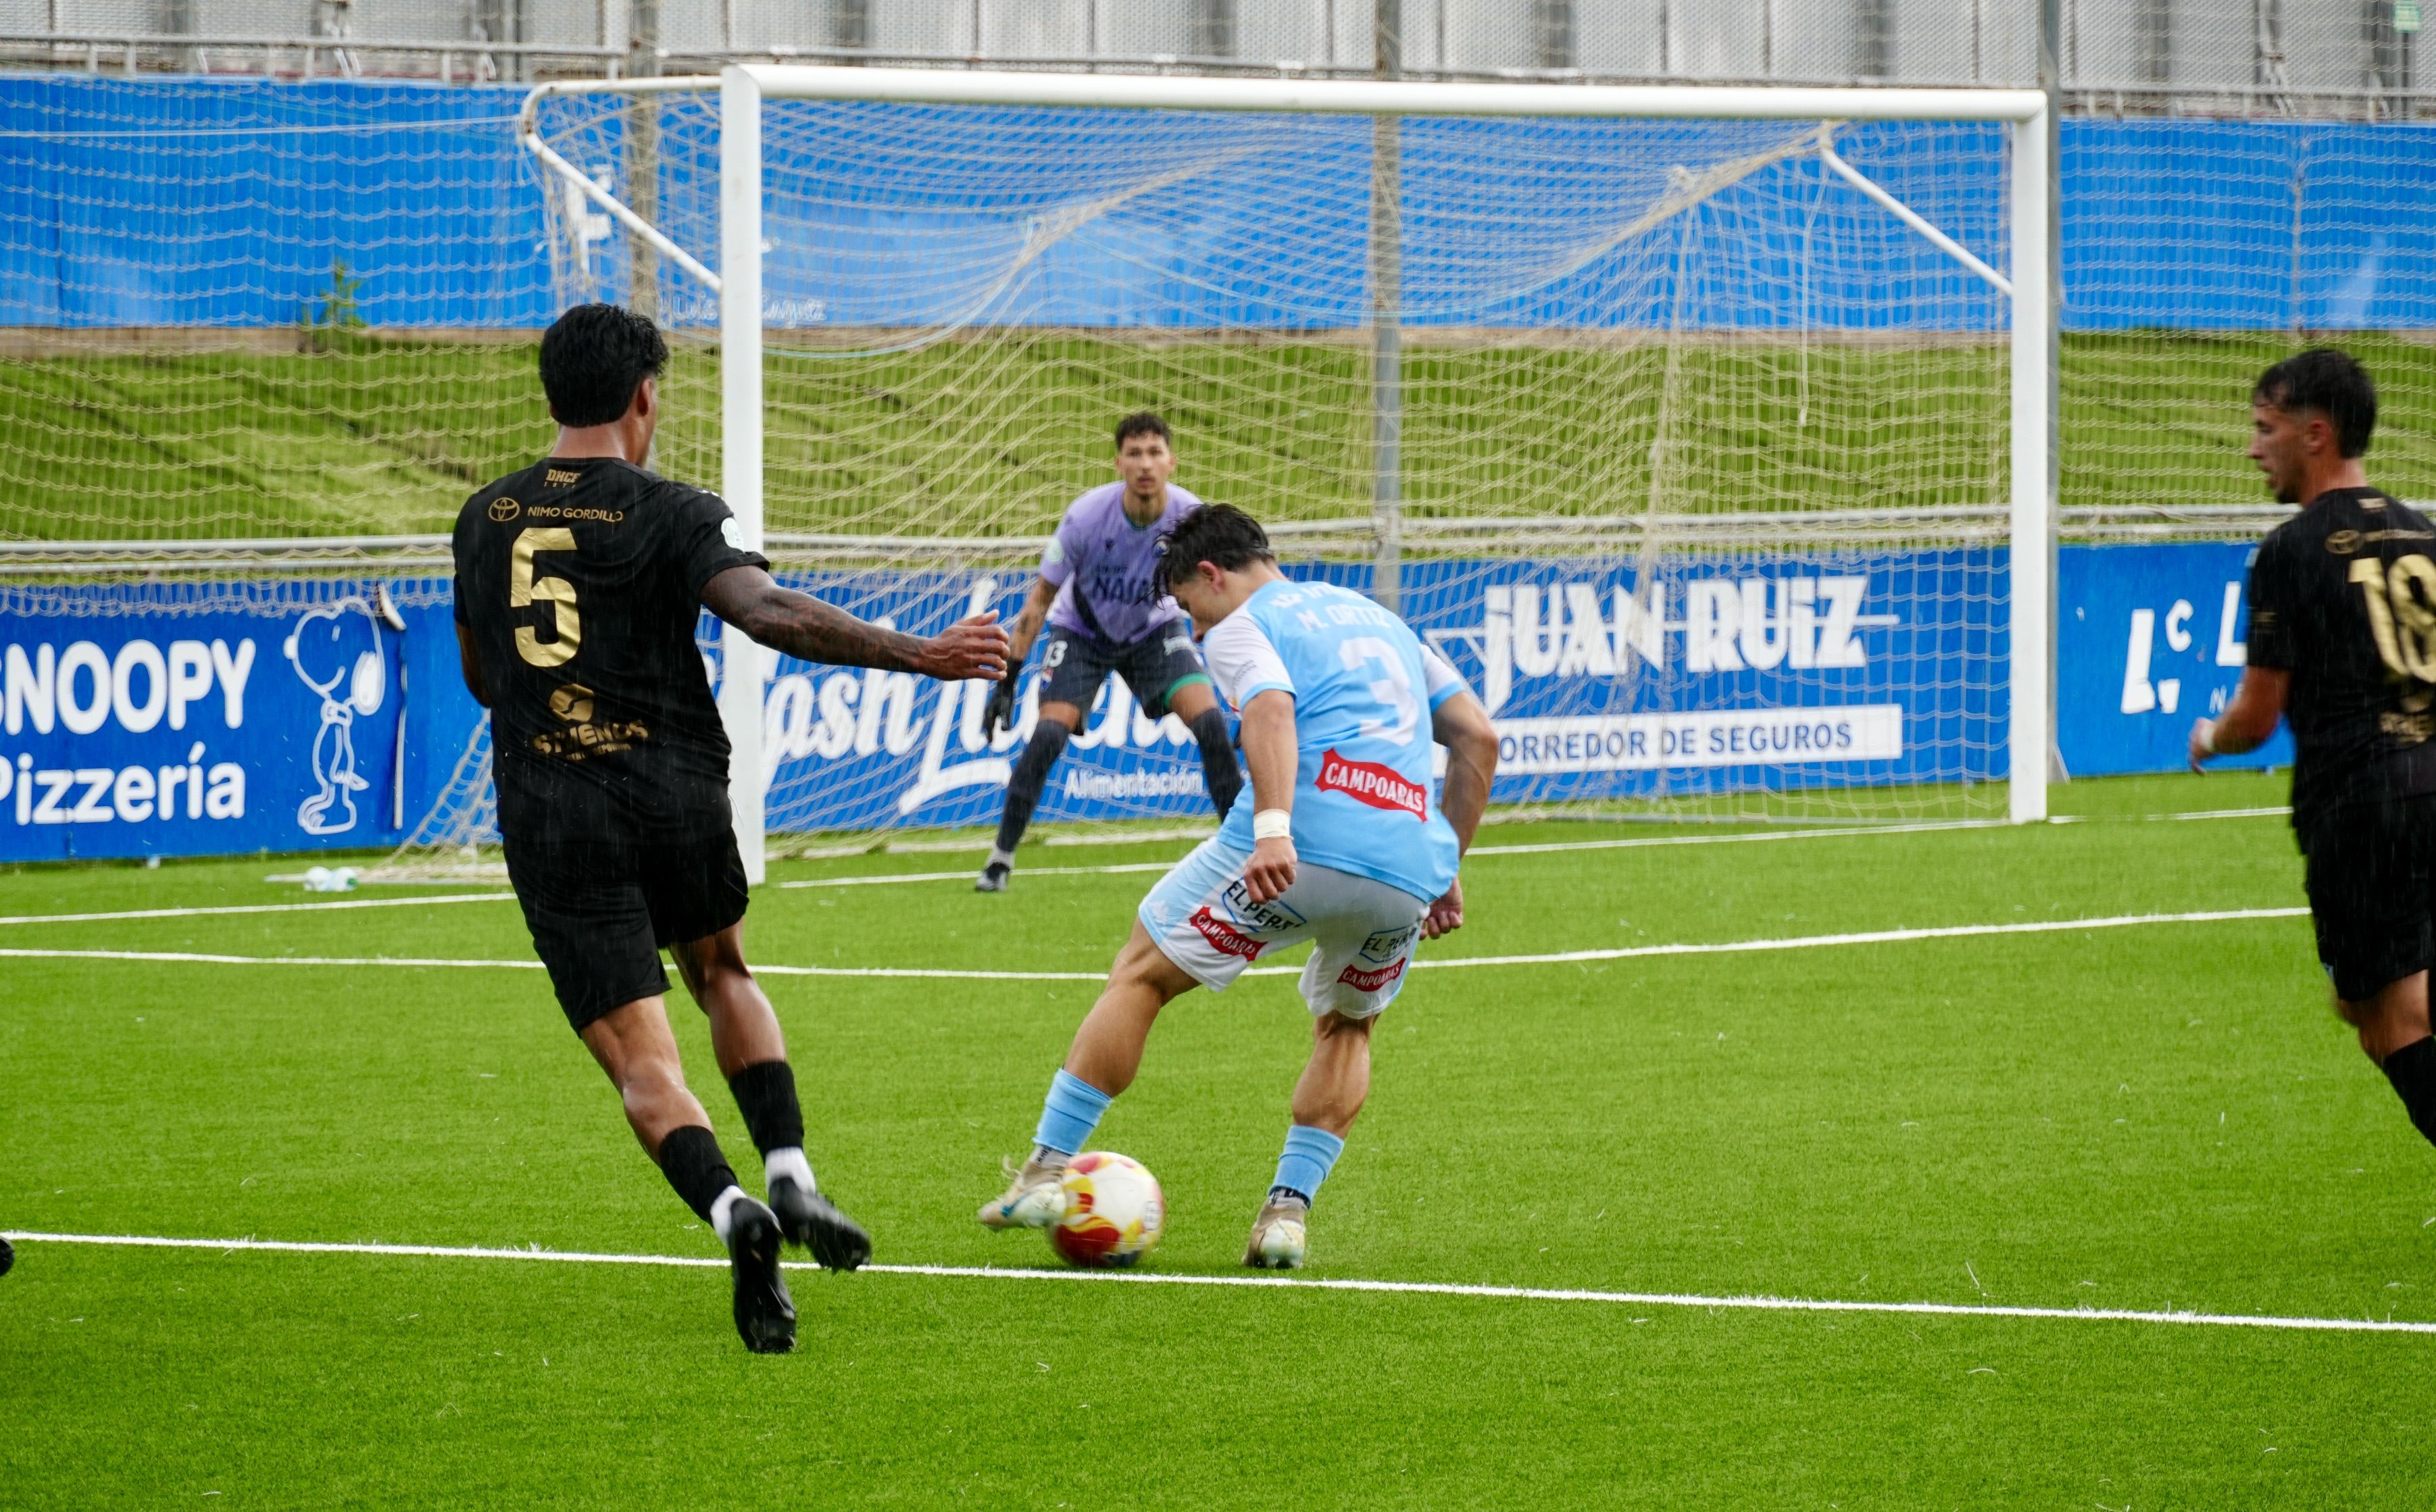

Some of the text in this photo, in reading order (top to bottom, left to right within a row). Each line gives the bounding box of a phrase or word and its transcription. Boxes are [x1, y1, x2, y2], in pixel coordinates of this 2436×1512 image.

[545, 468, 582, 483] DHCF
[527, 506, 623, 522] NIMO GORDILLO
[510, 528, 582, 667] 5
[1043, 640, 1068, 669] 13
[0, 637, 257, 736] NOOPY
[1338, 636, 1419, 747] 3
[1498, 722, 1851, 763] ORREDOR DE SEGUROS
[1063, 764, 1204, 801] Alimentación
[1324, 762, 1424, 812] CAMPOARAS
[1226, 880, 1247, 907] EL
[1360, 937, 1383, 951] EL
